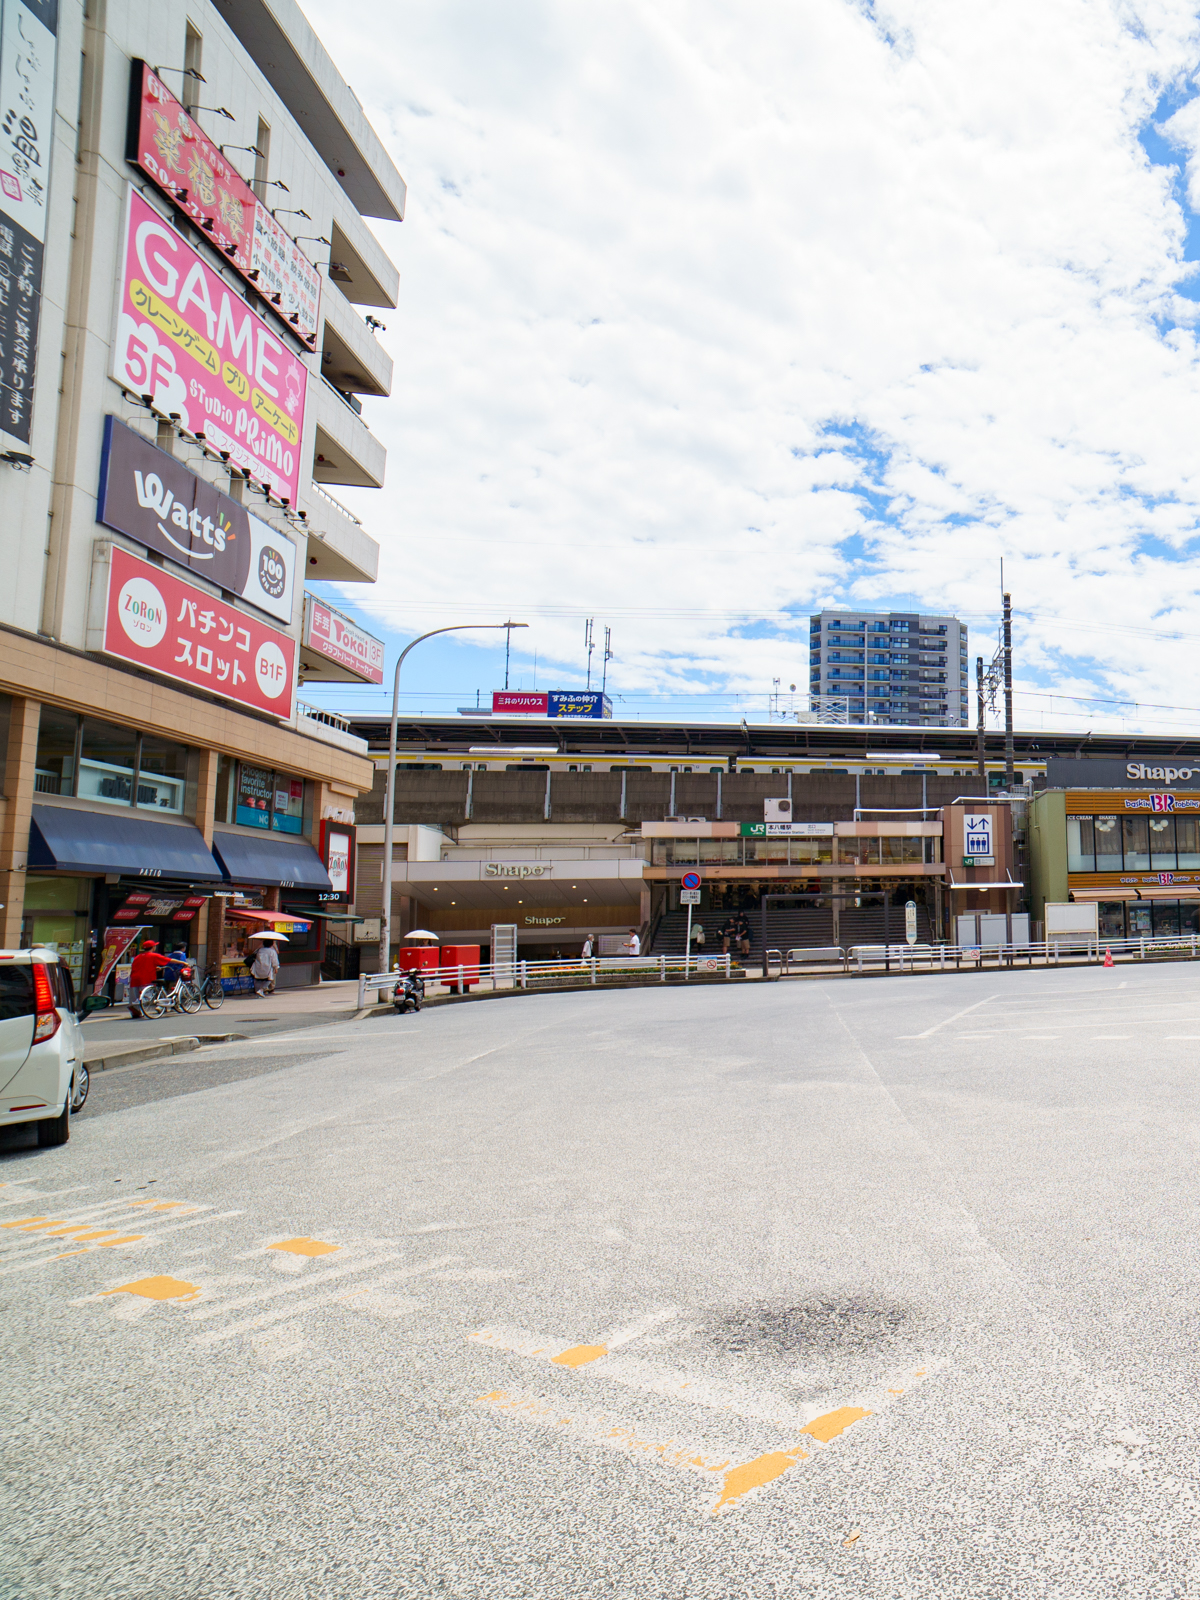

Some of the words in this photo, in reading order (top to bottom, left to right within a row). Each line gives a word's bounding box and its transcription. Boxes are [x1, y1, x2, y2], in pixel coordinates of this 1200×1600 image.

[147, 75, 169, 106] 6F
[135, 221, 282, 398] GAME
[125, 334, 175, 396] 5F
[136, 287, 217, 372] クレーンゲーム
[226, 366, 246, 394] プリ
[255, 392, 297, 439] アーケード
[134, 470, 227, 552] Watts
[262, 554, 283, 580] 100
[132, 619, 152, 633] ゾロン
[177, 598, 251, 652] パチンコ
[314, 611, 330, 631] 手芸
[174, 637, 246, 686] スロット
[371, 645, 381, 662] 3F
[259, 659, 284, 681] B1F
[356, 659, 373, 676] トーカイ
[498, 697, 543, 705] 三井のリハウス
[552, 694, 598, 703] すみふの仲介
[558, 704, 593, 713] ステップ
[241, 764, 267, 779] Choose
[1126, 763, 1200, 784] Shapo
[241, 773, 265, 788] favorite
[240, 783, 273, 799] instructor
[1124, 799, 1150, 808] baskin
[1174, 800, 1200, 808] robbins
[750, 824, 765, 832] JR
[139, 868, 162, 877] PATIO
[485, 863, 553, 879] Shapo
[280, 880, 295, 888] PATIO
[318, 893, 340, 901] 12:30
[524, 916, 566, 926] Shapo
